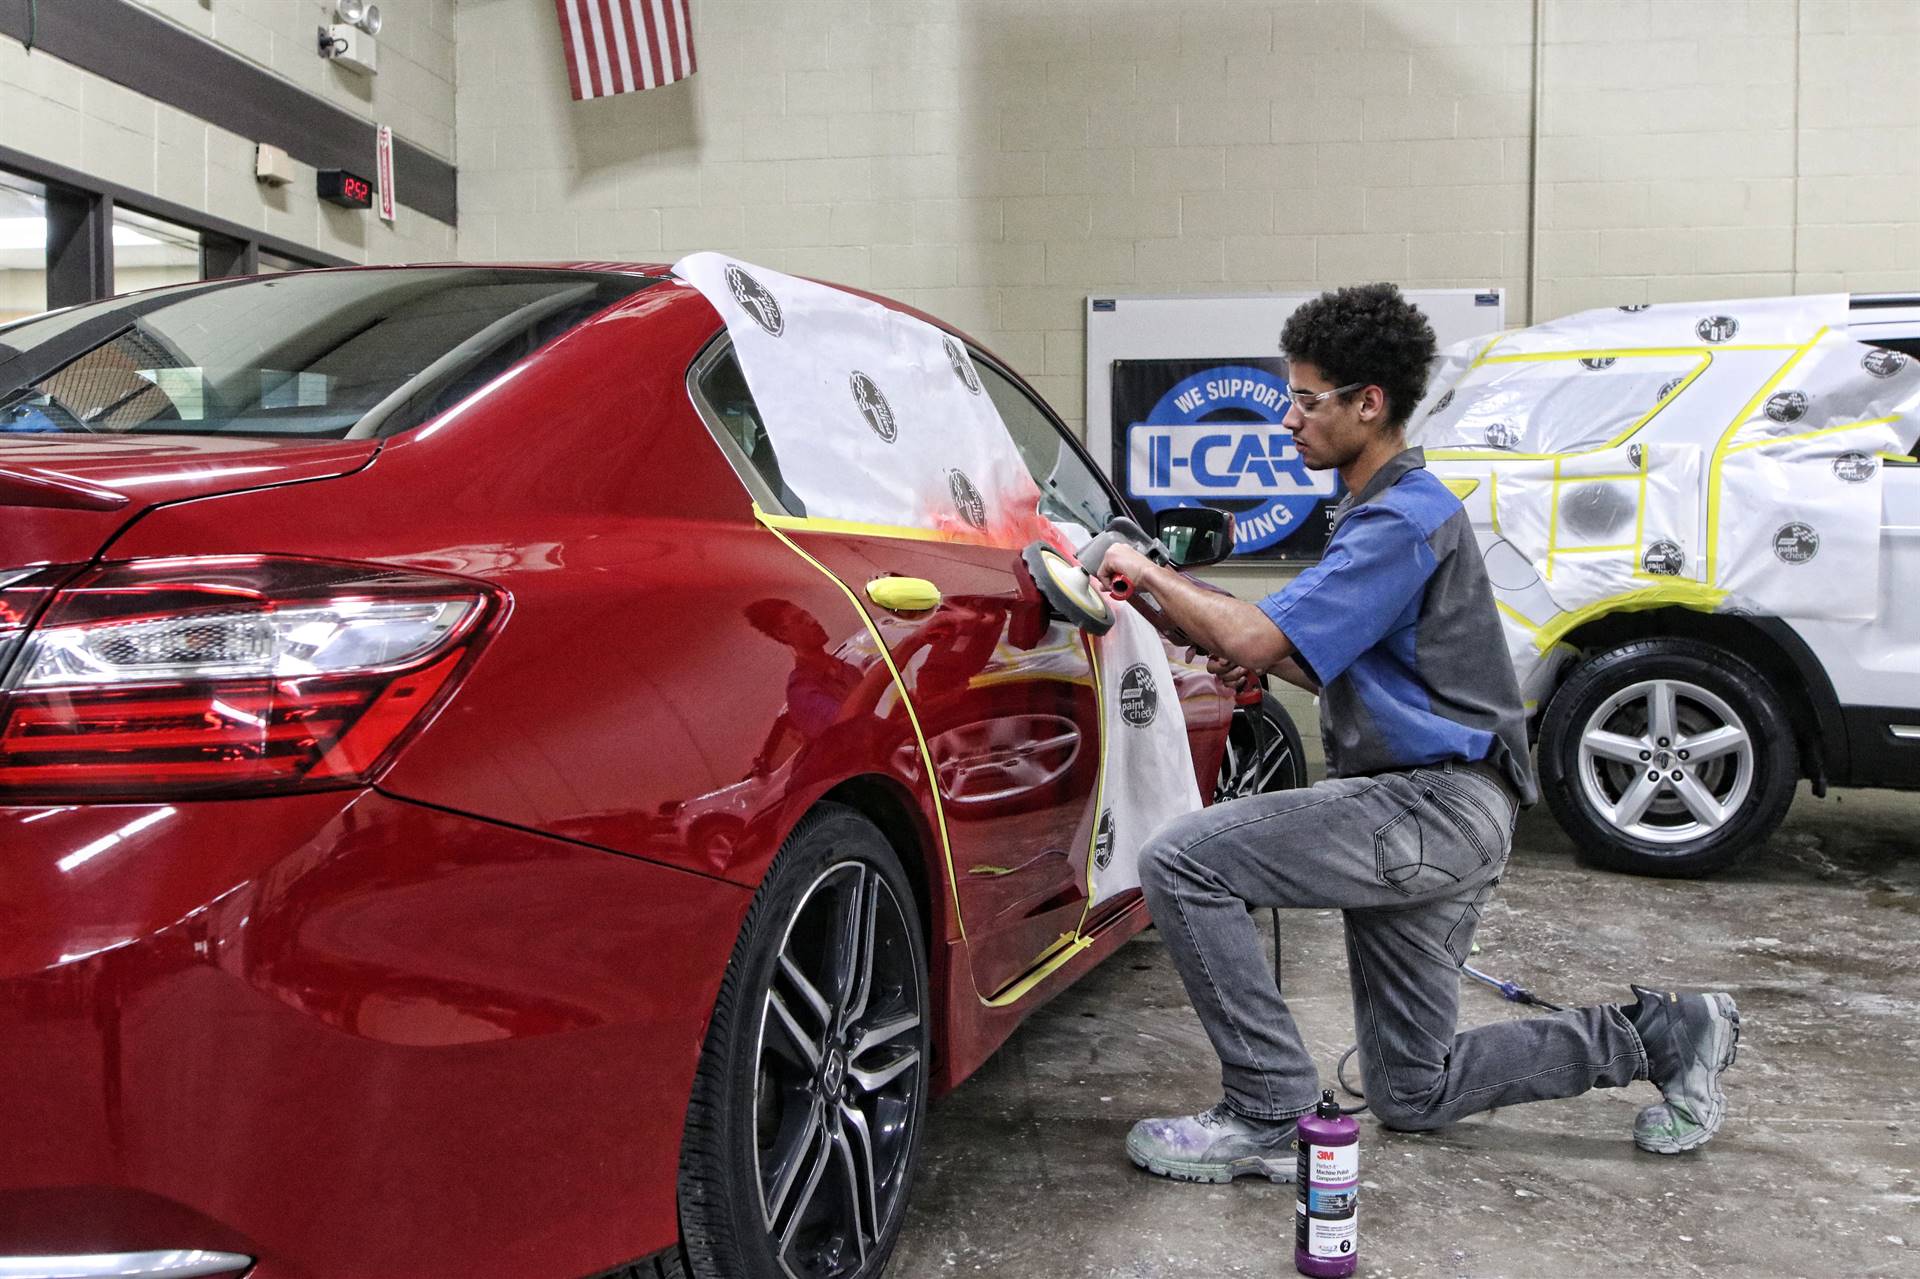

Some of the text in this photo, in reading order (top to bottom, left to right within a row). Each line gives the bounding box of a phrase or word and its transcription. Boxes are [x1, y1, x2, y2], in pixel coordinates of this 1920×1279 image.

[1174, 379, 1289, 414] WE SUPPORT
[1149, 434, 1314, 488] I-CAR
[1778, 545, 1798, 554] paint
[1785, 552, 1809, 560] check
[1122, 699, 1144, 715] paint
[1130, 707, 1154, 719] check
[1316, 1151, 1334, 1161] 3M
[1343, 1241, 1349, 1251] 2
